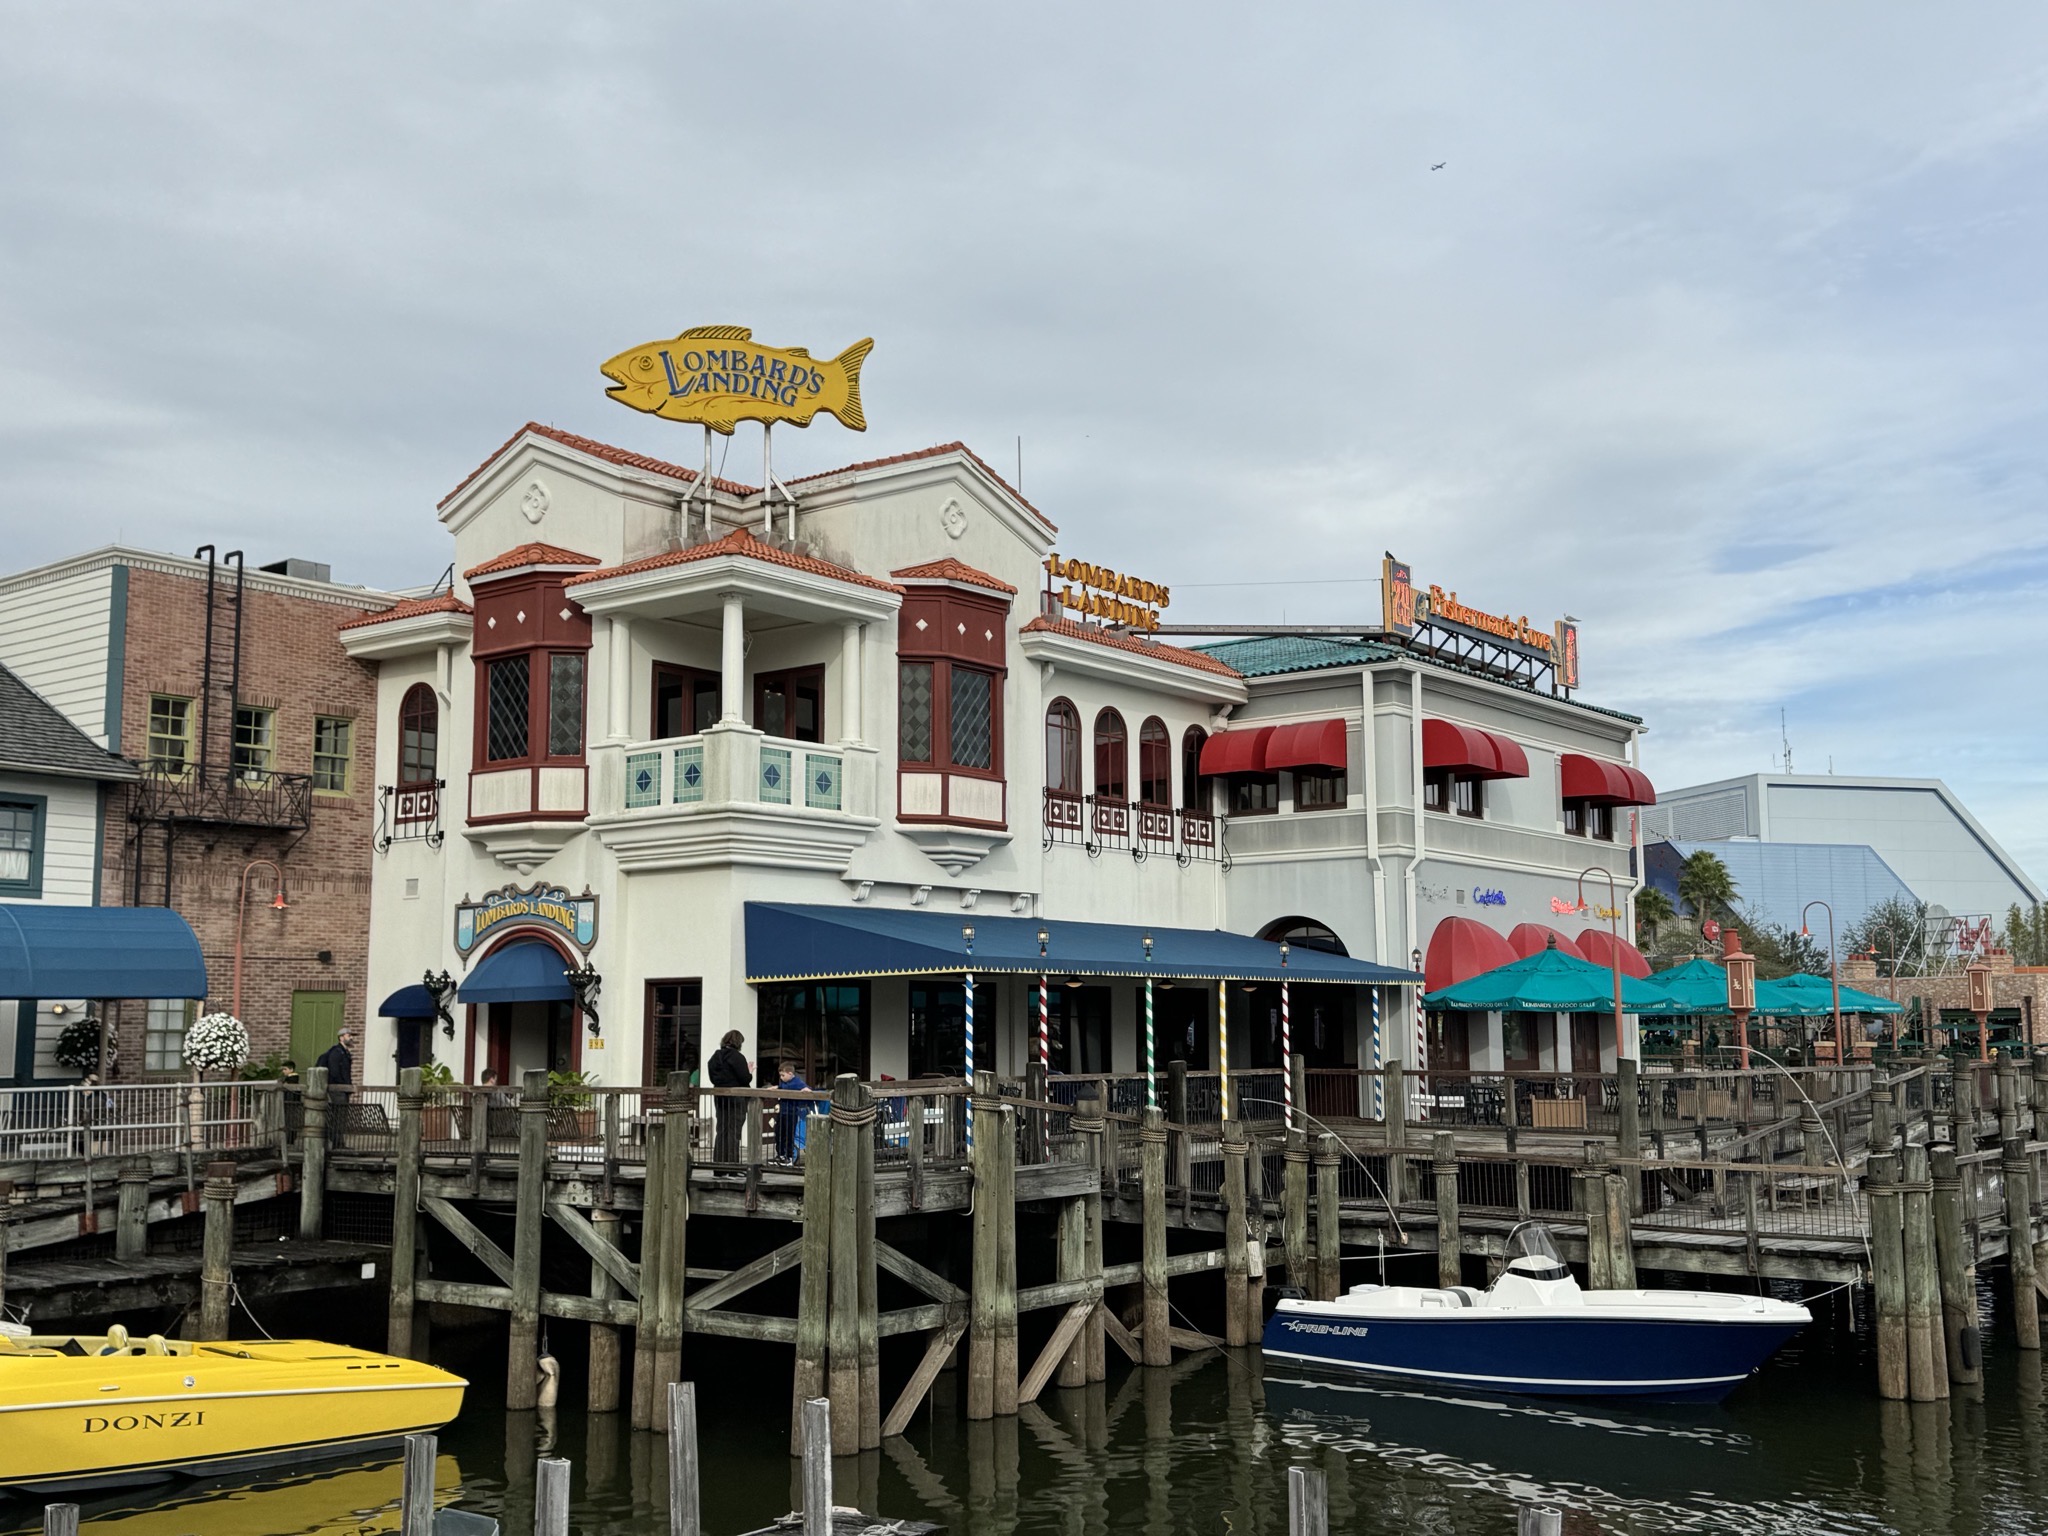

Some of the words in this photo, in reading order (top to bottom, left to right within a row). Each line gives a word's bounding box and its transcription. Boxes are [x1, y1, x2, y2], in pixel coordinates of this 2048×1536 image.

[658, 349, 826, 396] LOMBARD'S
[1050, 552, 1170, 609] LOMBARD'S
[1062, 584, 1161, 632] LANDING
[1429, 584, 1516, 640] Fisherman's
[1517, 615, 1552, 651] Cove
[530, 900, 576, 934] LANDING
[82, 1411, 206, 1434] DONZI
